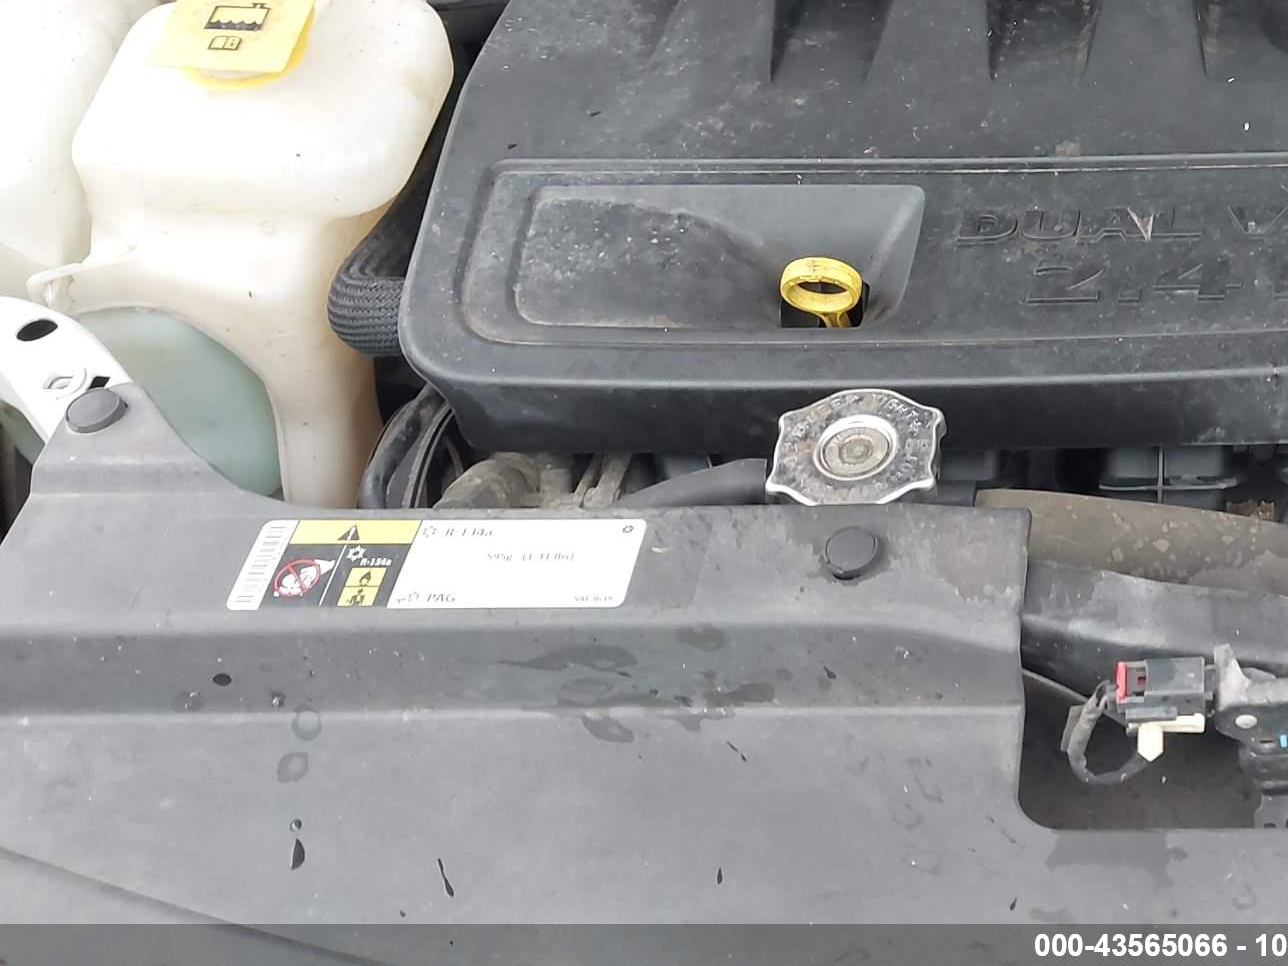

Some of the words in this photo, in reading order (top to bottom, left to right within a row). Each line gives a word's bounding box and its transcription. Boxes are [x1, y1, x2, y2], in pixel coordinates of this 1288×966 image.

[955, 206, 1202, 248] DUAL
[360, 556, 393, 568] R-134a
[427, 592, 457, 604] PAG
